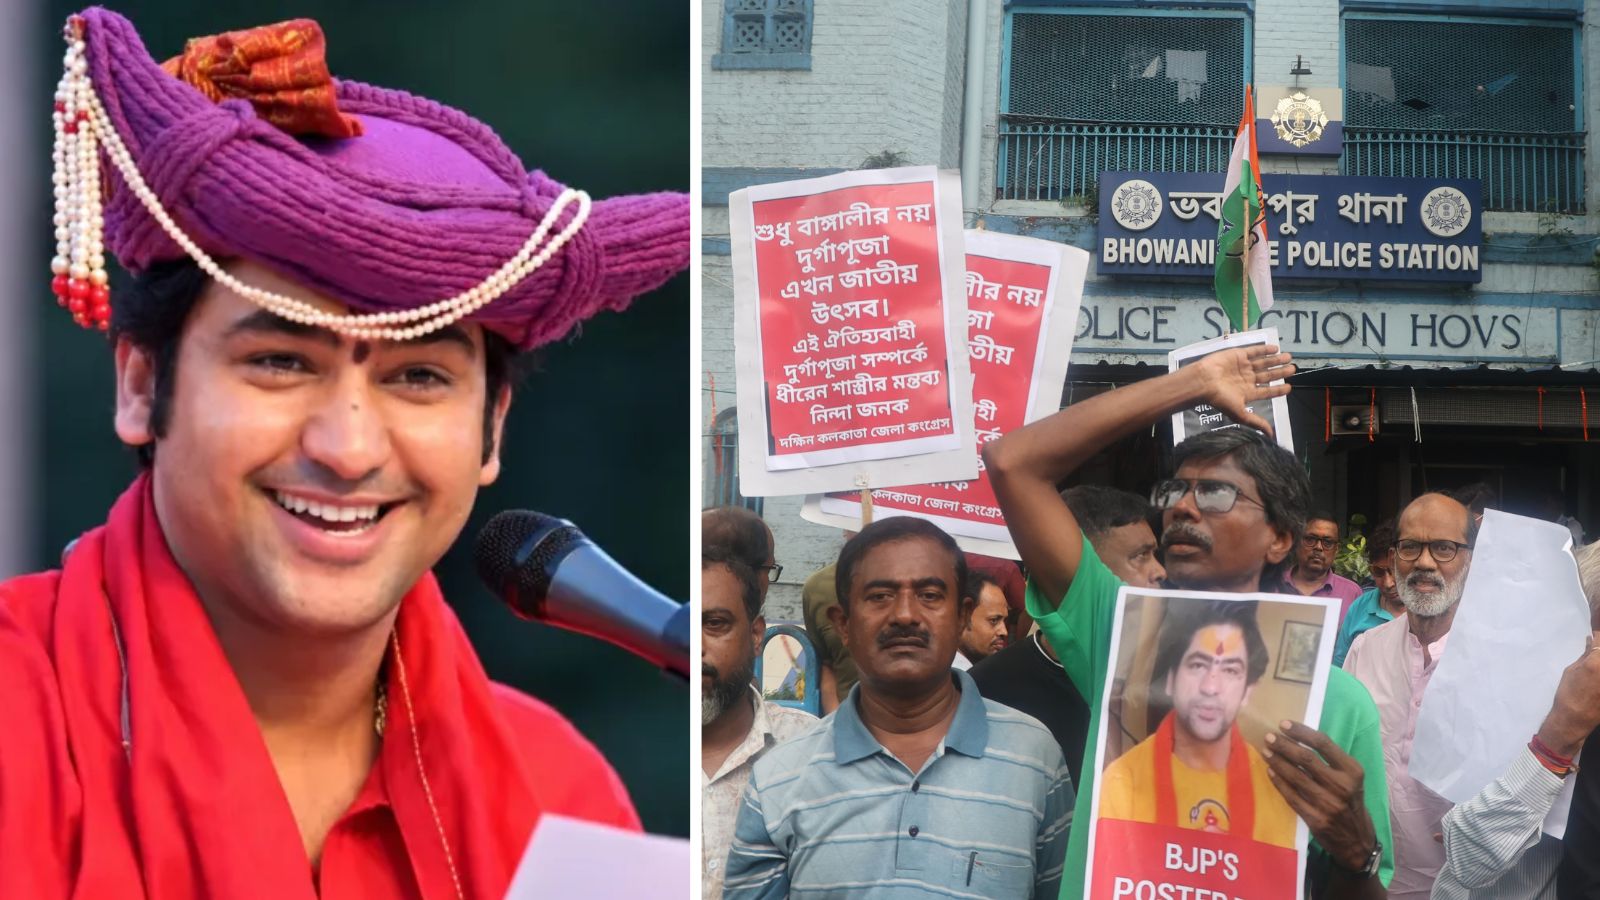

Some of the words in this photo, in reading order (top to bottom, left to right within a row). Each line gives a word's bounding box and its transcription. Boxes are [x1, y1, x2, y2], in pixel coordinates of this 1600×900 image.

[755, 222, 794, 247] শুধু
[797, 202, 890, 236] বাঙ্গালীর
[896, 203, 931, 223] নয়
[1169, 190, 1319, 235] ভবপুর
[1337, 192, 1408, 224] থানা
[796, 235, 890, 273] দুর্গাপূজা
[1103, 237, 1280, 266] BHOWANIE
[1287, 240, 1372, 268] POLICE
[1379, 242, 1479, 271] STATION
[781, 274, 834, 299] এখন
[838, 260, 918, 288] জাতীয়
[1007, 284, 1043, 307] নয়
[793, 333, 820, 353] এই
[824, 320, 916, 349] ঐতিহ্যবাহী
[1203, 306, 1386, 347] SCTION
[1410, 313, 1521, 350] HOVS
[784, 354, 856, 385] দুর্গাপূজা
[860, 342, 928, 368] সম্পর্কে
[776, 383, 828, 403] ধীরেন
[832, 372, 887, 397] শাস্ত্রীর
[892, 370, 940, 389] মন্তব্য
[810, 404, 852, 425] নিন্দা
[856, 398, 910, 417] জনক
[817, 427, 867, 444] কলকাতা
[871, 422, 905, 438] জেলা
[907, 417, 950, 433] কংগ্রেস
[924, 497, 960, 512] জেলা
[1165, 842, 1239, 881] BJP'S
